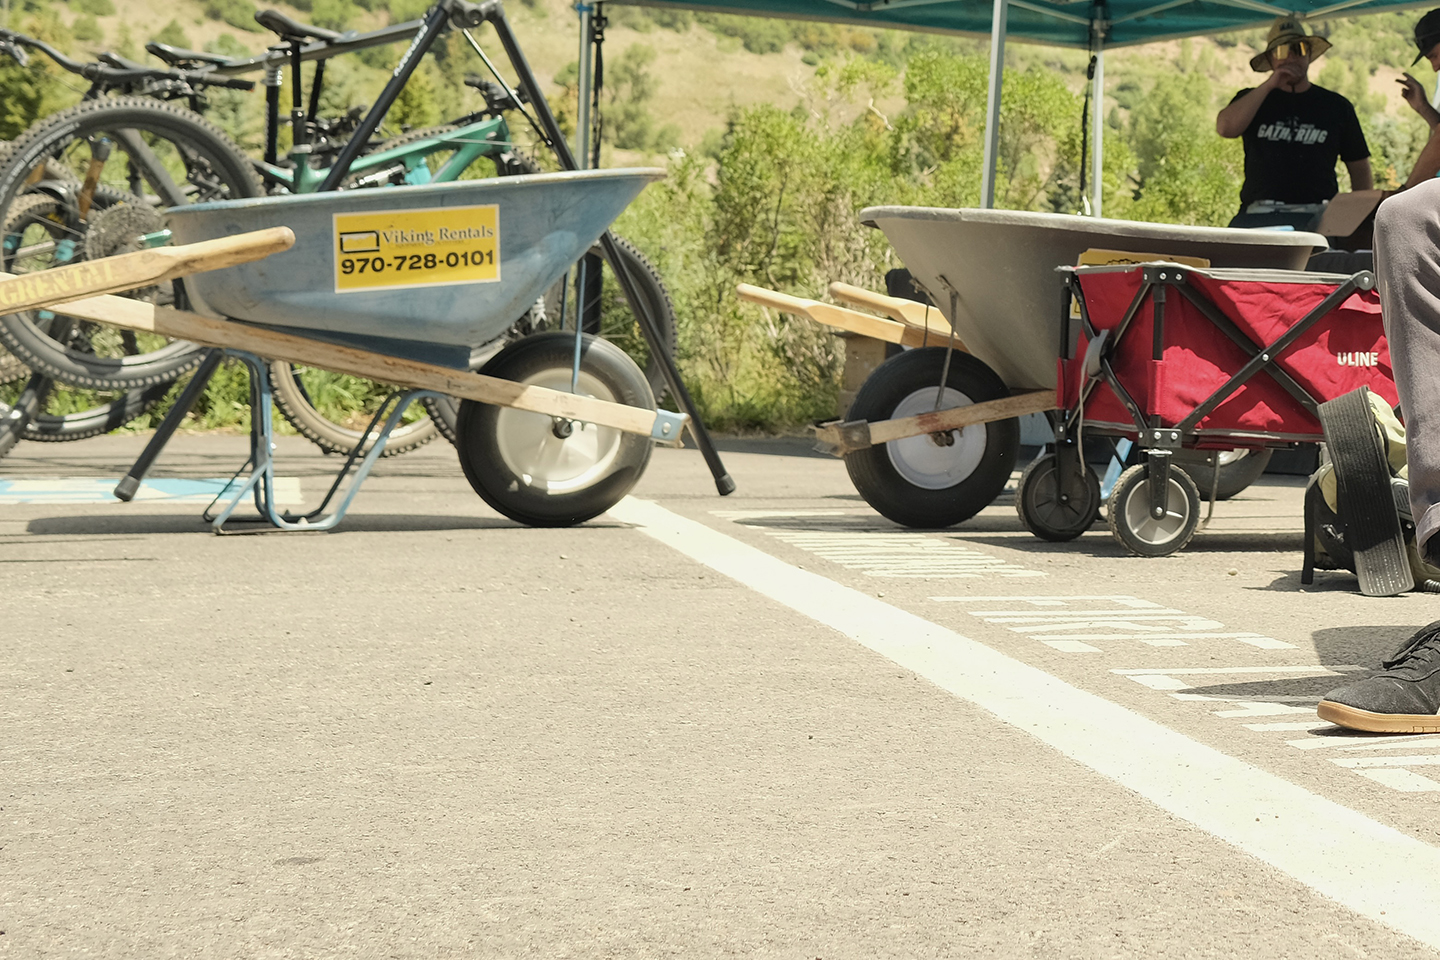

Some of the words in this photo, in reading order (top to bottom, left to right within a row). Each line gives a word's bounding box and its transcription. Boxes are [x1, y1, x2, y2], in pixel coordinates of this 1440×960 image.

[382, 229, 434, 245] Viking
[439, 225, 494, 241] Rentals
[341, 250, 494, 275] 970-728-0101
[1337, 351, 1379, 367] ULINE
